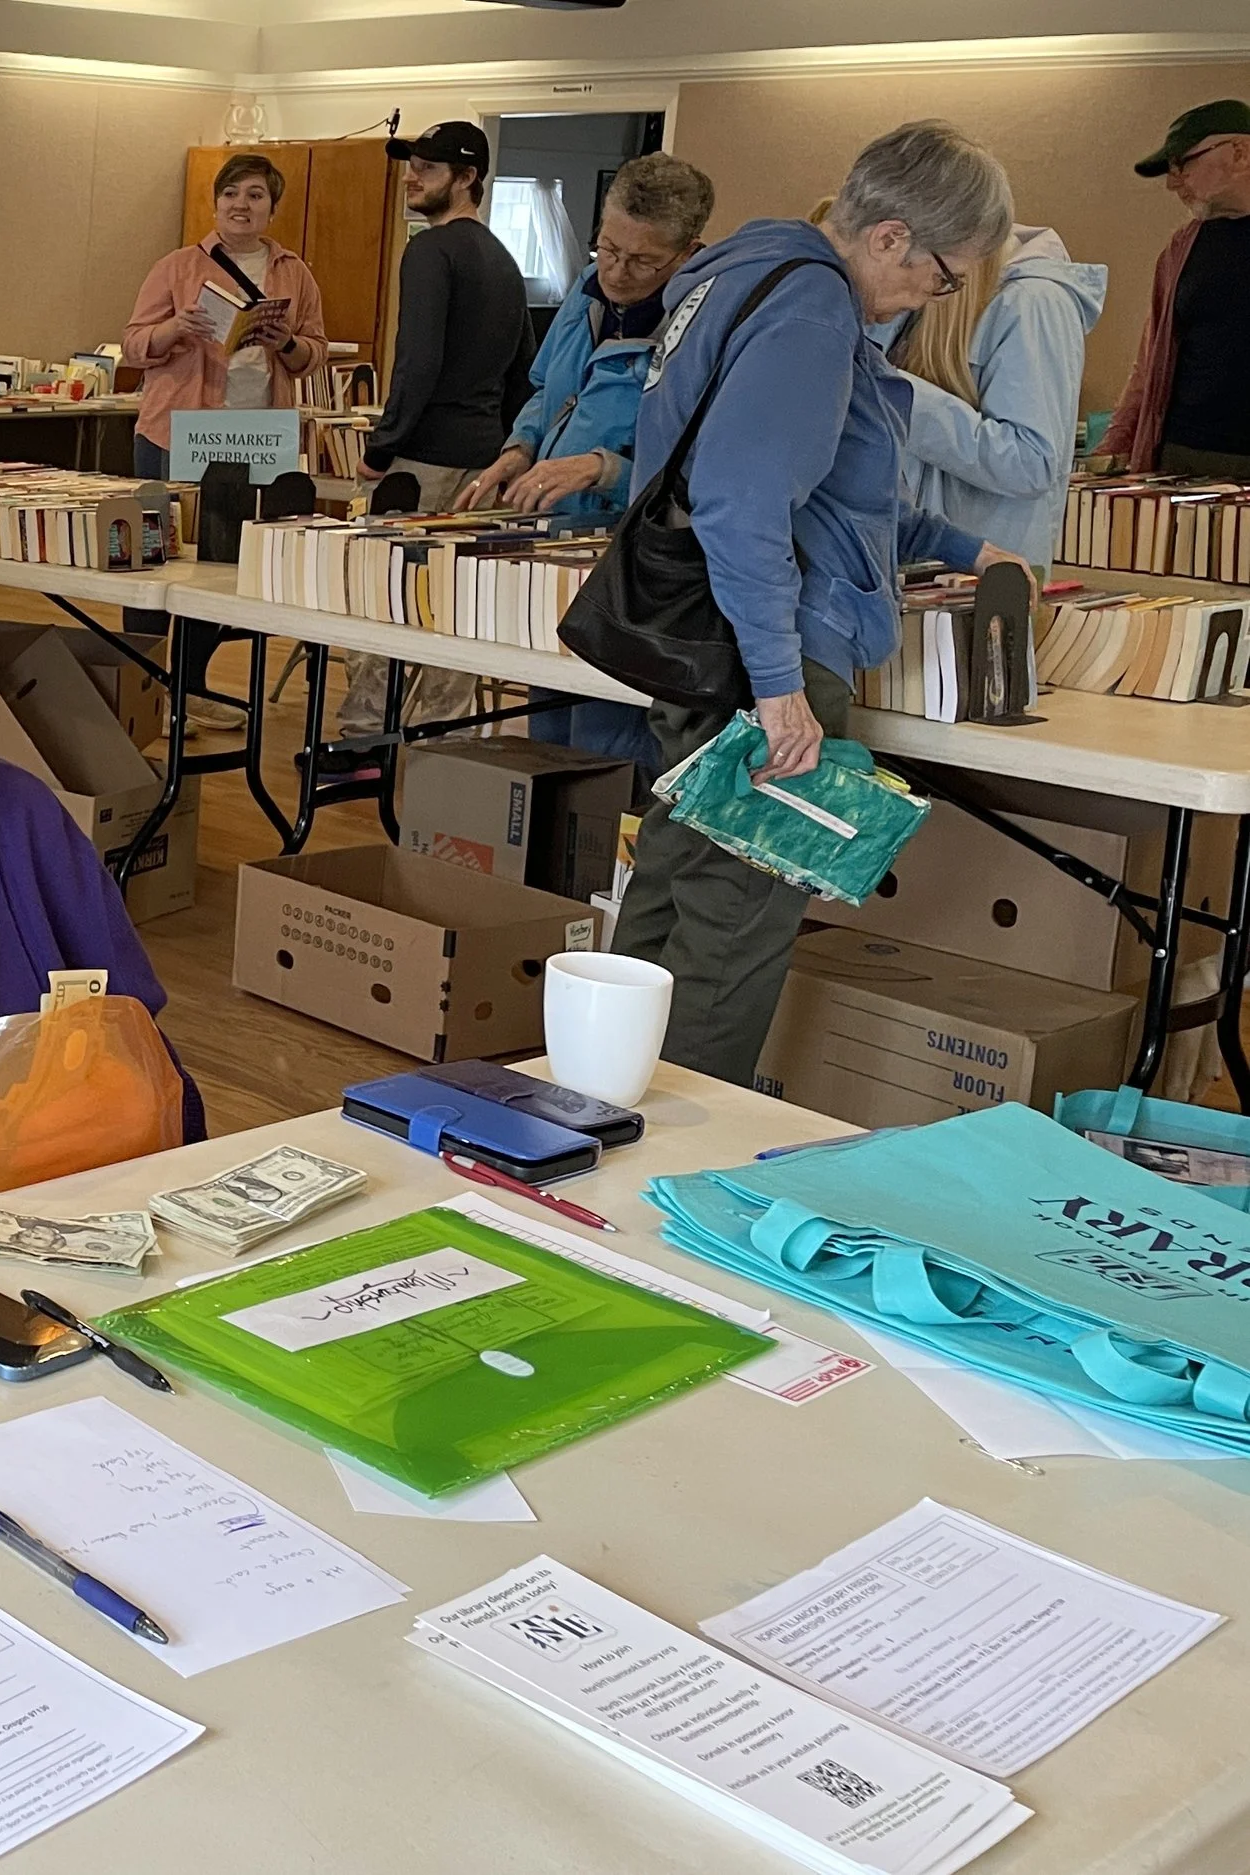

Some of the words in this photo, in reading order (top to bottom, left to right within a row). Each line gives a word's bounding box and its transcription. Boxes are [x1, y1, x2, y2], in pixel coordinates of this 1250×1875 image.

[188, 433, 222, 445] MASS
[225, 433, 282, 447] MARKET
[191, 451, 277, 465] PAPERBACKS
[510, 787, 524, 839] SMALL
[324, 905, 351, 920] PACKER
[927, 1030, 1008, 1069] CONTENTS
[953, 1071, 1005, 1103] FLOOR
[1027, 1196, 1250, 1287] RARY
[439, 1613, 460, 1623] Our
[456, 1600, 491, 1616] library
[487, 1582, 528, 1603] depends
[526, 1576, 540, 1584] on
[535, 1570, 552, 1578] its
[460, 1606, 500, 1628] Friends!
[497, 1601, 520, 1612] Join
[516, 1595, 531, 1603] us
[526, 1580, 558, 1598] today!
[754, 1626, 785, 1642] NORTH
[779, 1604, 823, 1629] TILLAMOOK
[817, 1588, 850, 1608] LIBRARY
[845, 1572, 878, 1591] FRIENDS
[777, 1616, 826, 1644] MEMBERSHIP
[826, 1594, 866, 1617] DONATION
[860, 1582, 884, 1597] FORM
[579, 1658, 604, 1671] How
[610, 1645, 632, 1658] join
[595, 1700, 623, 1712] North
[618, 1682, 658, 1702] Tillamook
[653, 1669, 686, 1685] Library
[679, 1654, 710, 1672] Friends
[606, 1712, 624, 1721] PO
[619, 1706, 638, 1716] Box
[688, 1672, 704, 1680] OR
[700, 1660, 725, 1675] 97130
[650, 1726, 683, 1742] Choose
[680, 1720, 693, 1728] an
[750, 1682, 761, 1690] or
[677, 1724, 715, 1742] business
[696, 1746, 729, 1761] Donate
[734, 1720, 775, 1744] someone's
[769, 1708, 795, 1723] honor
[725, 1774, 760, 1791] Include
[756, 1768, 770, 1776] us
[774, 1755, 792, 1768] your
[791, 1743, 817, 1758] estate
[813, 1724, 850, 1746] planning
